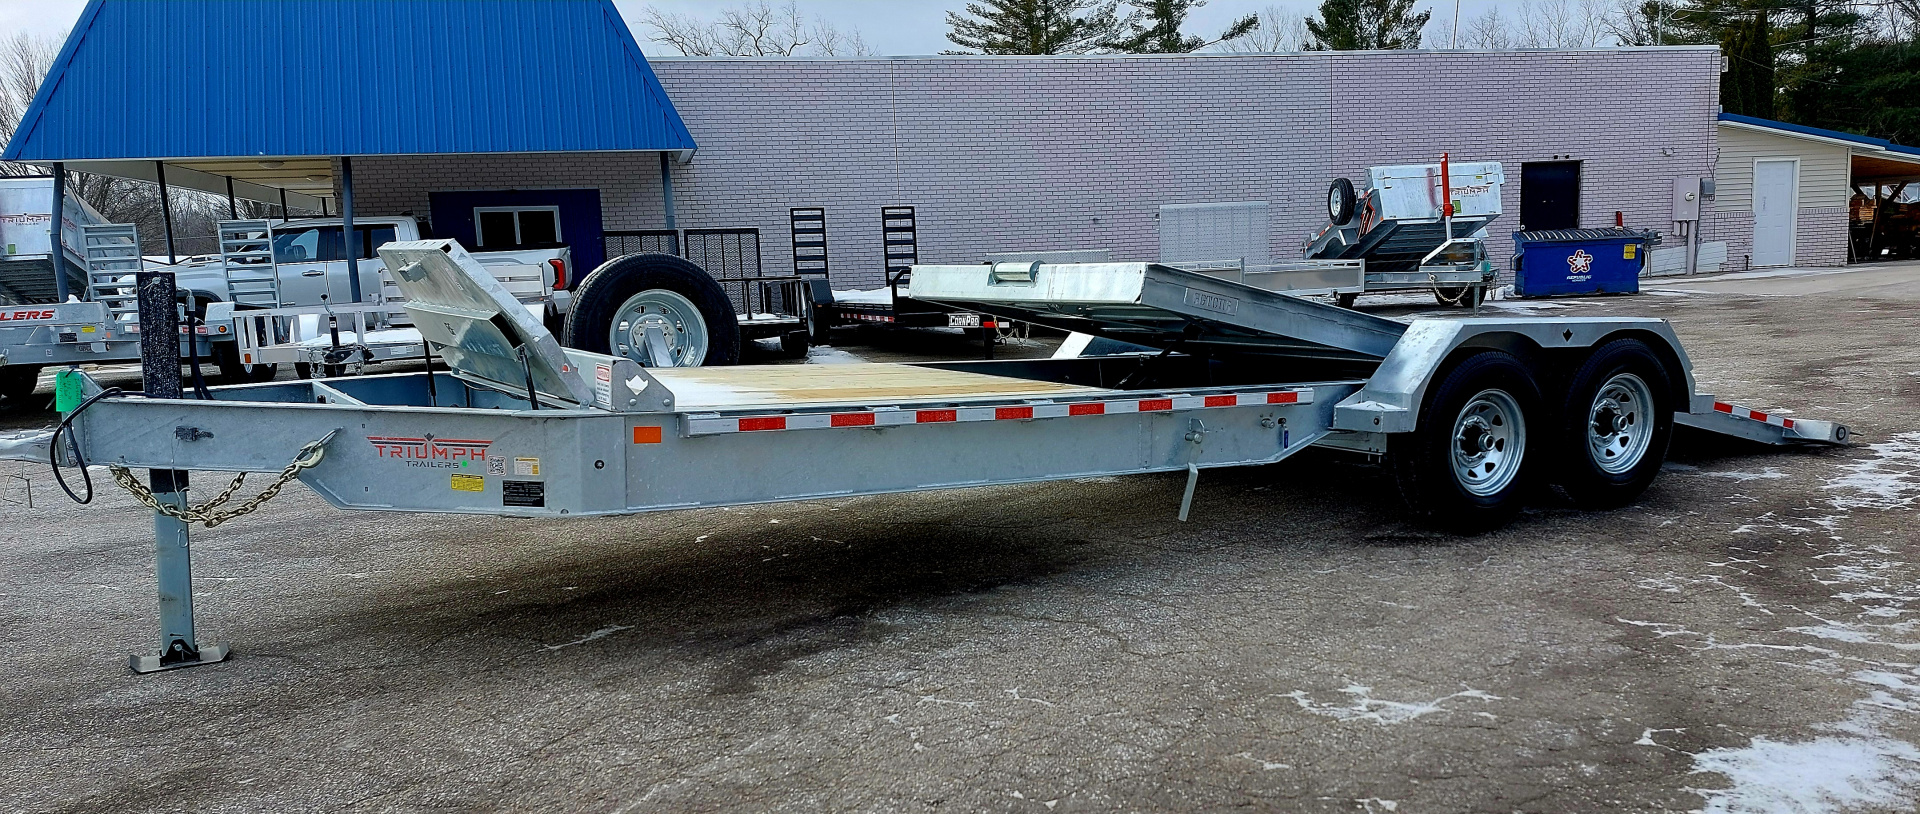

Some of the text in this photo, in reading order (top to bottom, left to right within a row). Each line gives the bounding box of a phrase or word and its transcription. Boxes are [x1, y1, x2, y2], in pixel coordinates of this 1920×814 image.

[1, 216, 51, 224] TRIUMPH
[0, 309, 55, 321] LERS
[376, 445, 486, 461] TRIUMPH
[405, 460, 459, 469] TRAILERS
